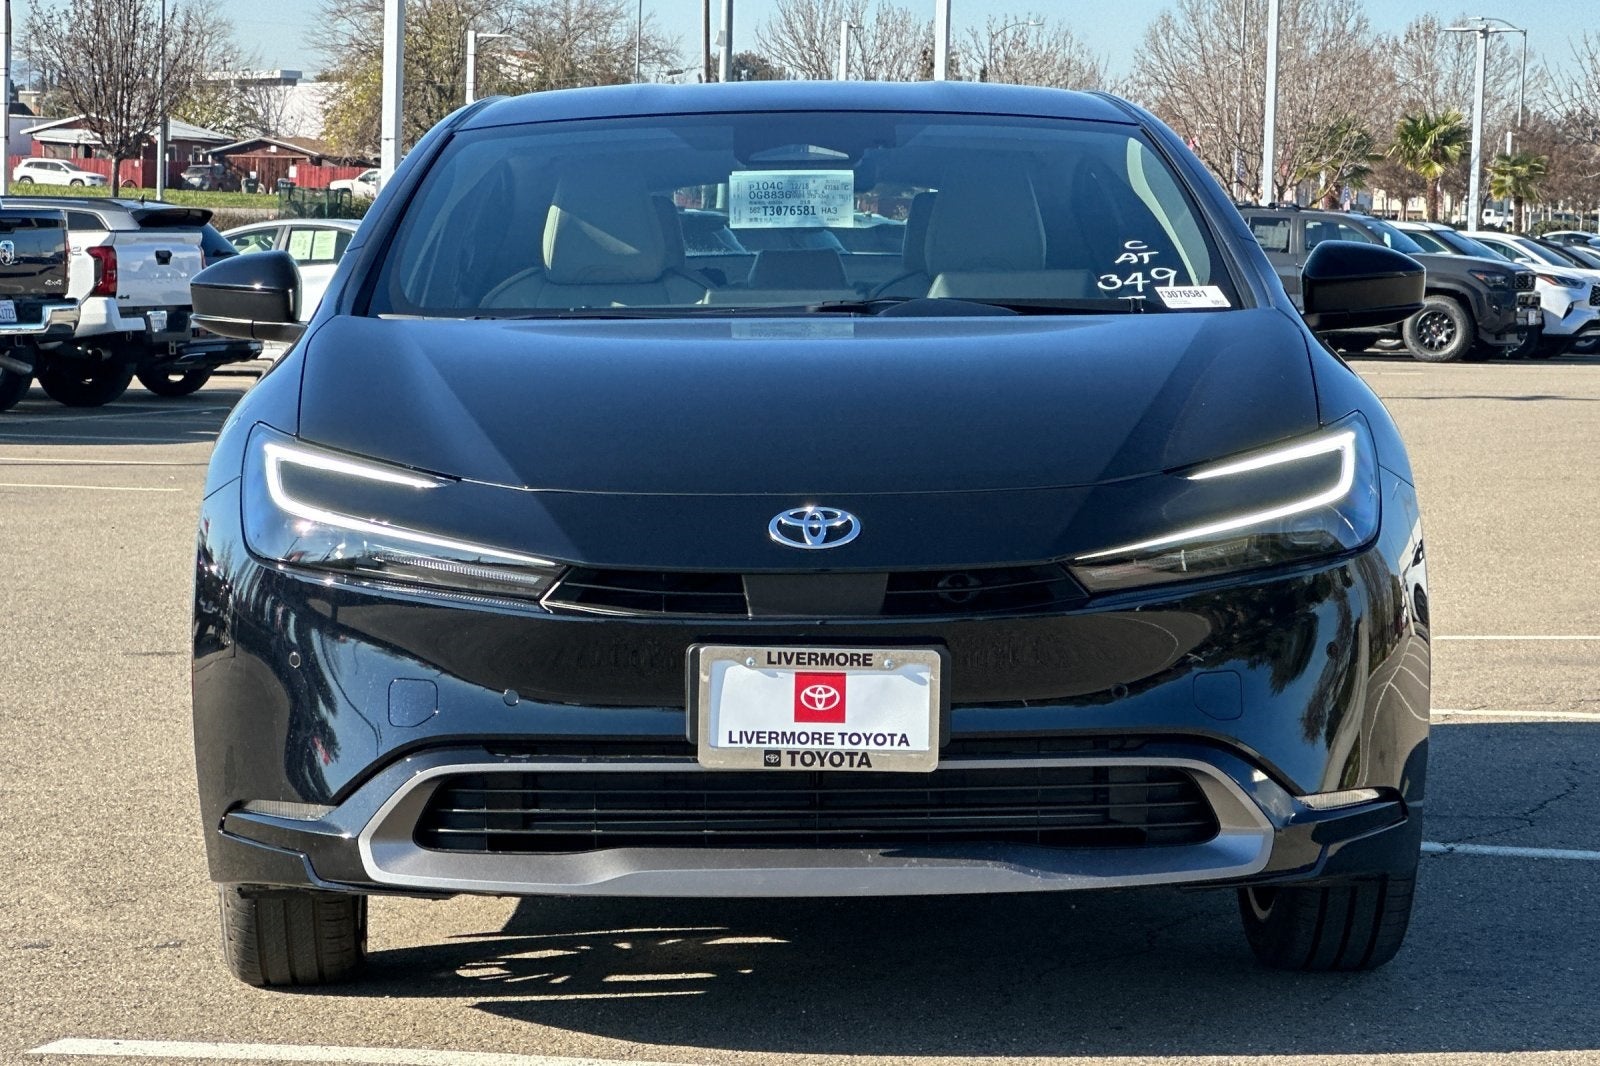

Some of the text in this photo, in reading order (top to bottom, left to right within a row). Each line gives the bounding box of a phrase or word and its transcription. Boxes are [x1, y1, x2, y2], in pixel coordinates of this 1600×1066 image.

[763, 205, 817, 216] T3076581
[1124, 240, 1148, 249] C
[1115, 251, 1159, 264] AT
[1097, 267, 1177, 293] 349
[766, 651, 874, 668] LIVERMORE
[728, 730, 910, 747] LIVERMORE TOYOTA
[786, 750, 873, 769] TOYOTA
